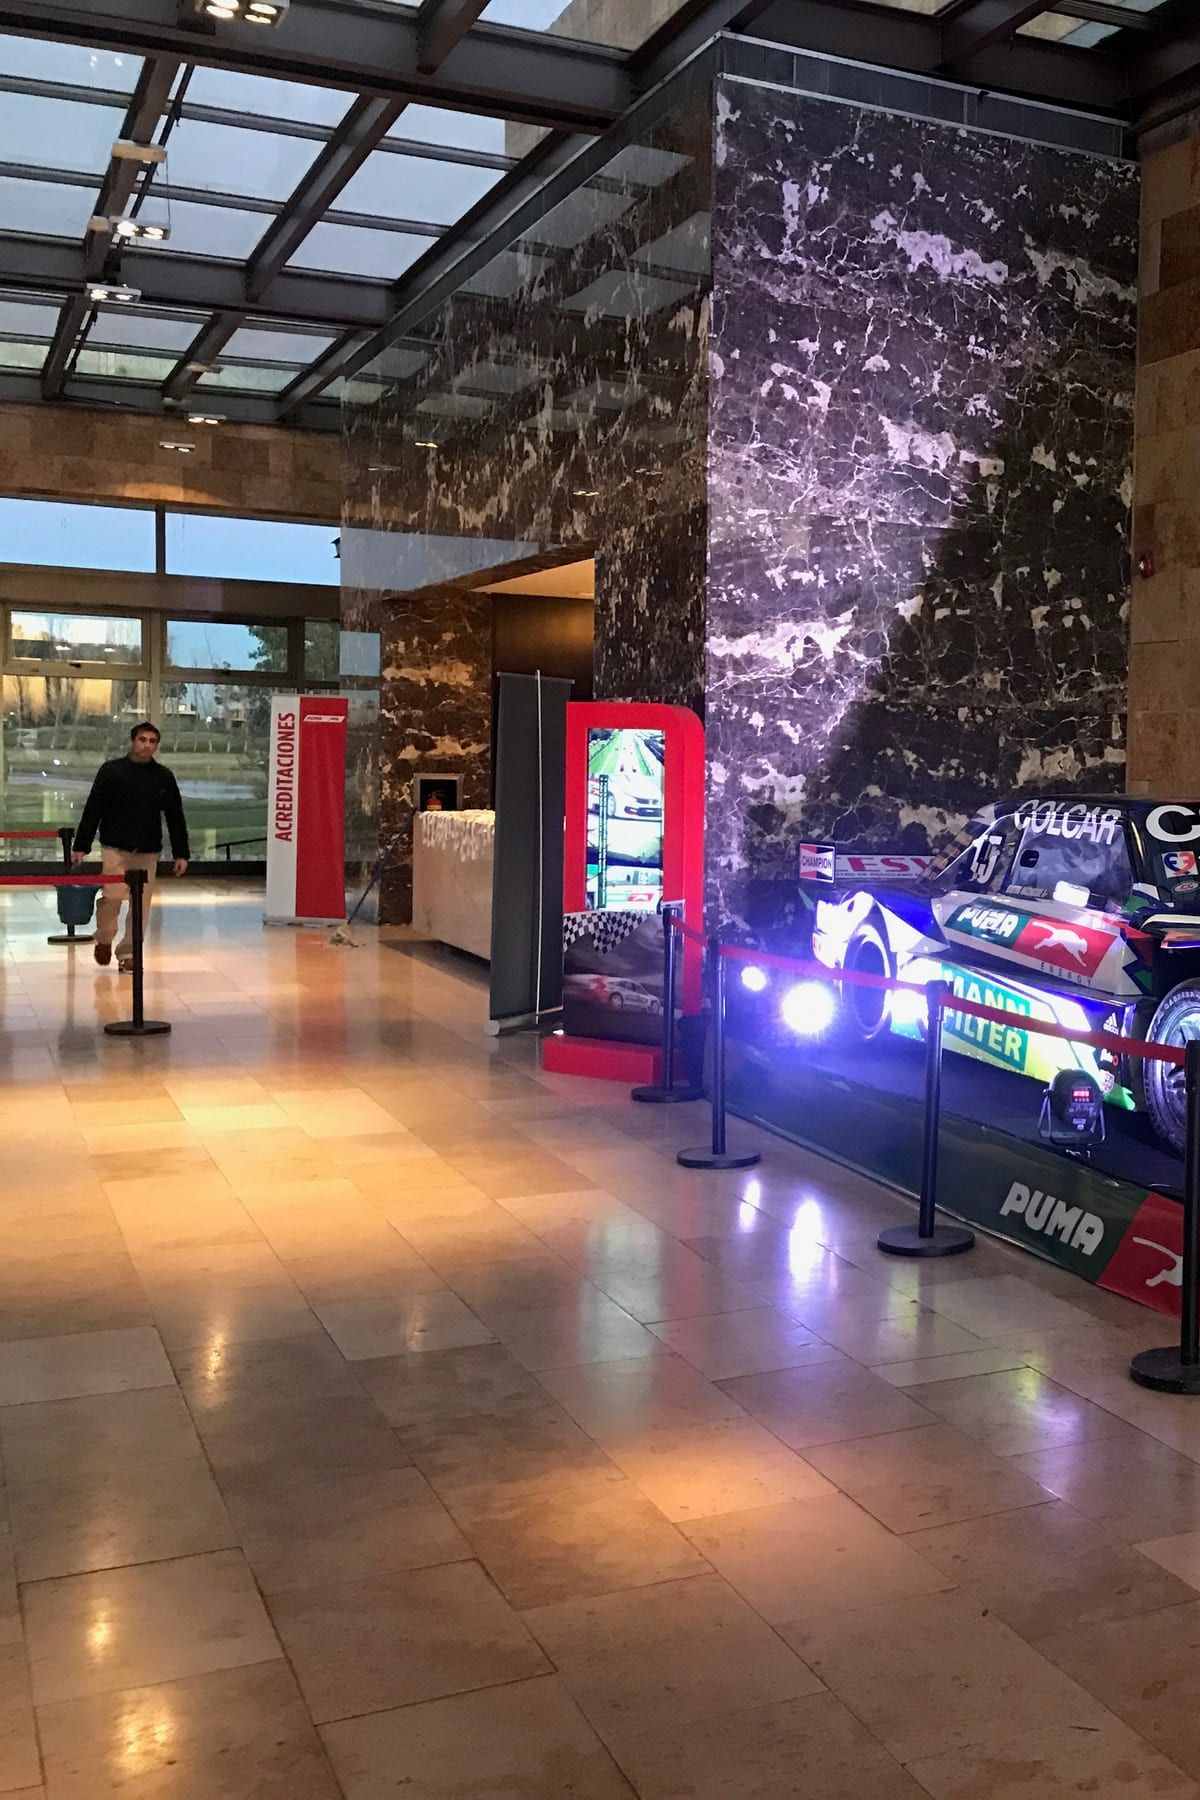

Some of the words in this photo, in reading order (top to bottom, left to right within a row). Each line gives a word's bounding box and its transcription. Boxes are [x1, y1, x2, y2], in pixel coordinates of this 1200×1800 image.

[275, 712, 295, 842] ACREDITACIONES
[1014, 799, 1122, 845] COLCAR
[801, 855, 832, 869] CHAMPION
[999, 1181, 1104, 1256] PUMA
